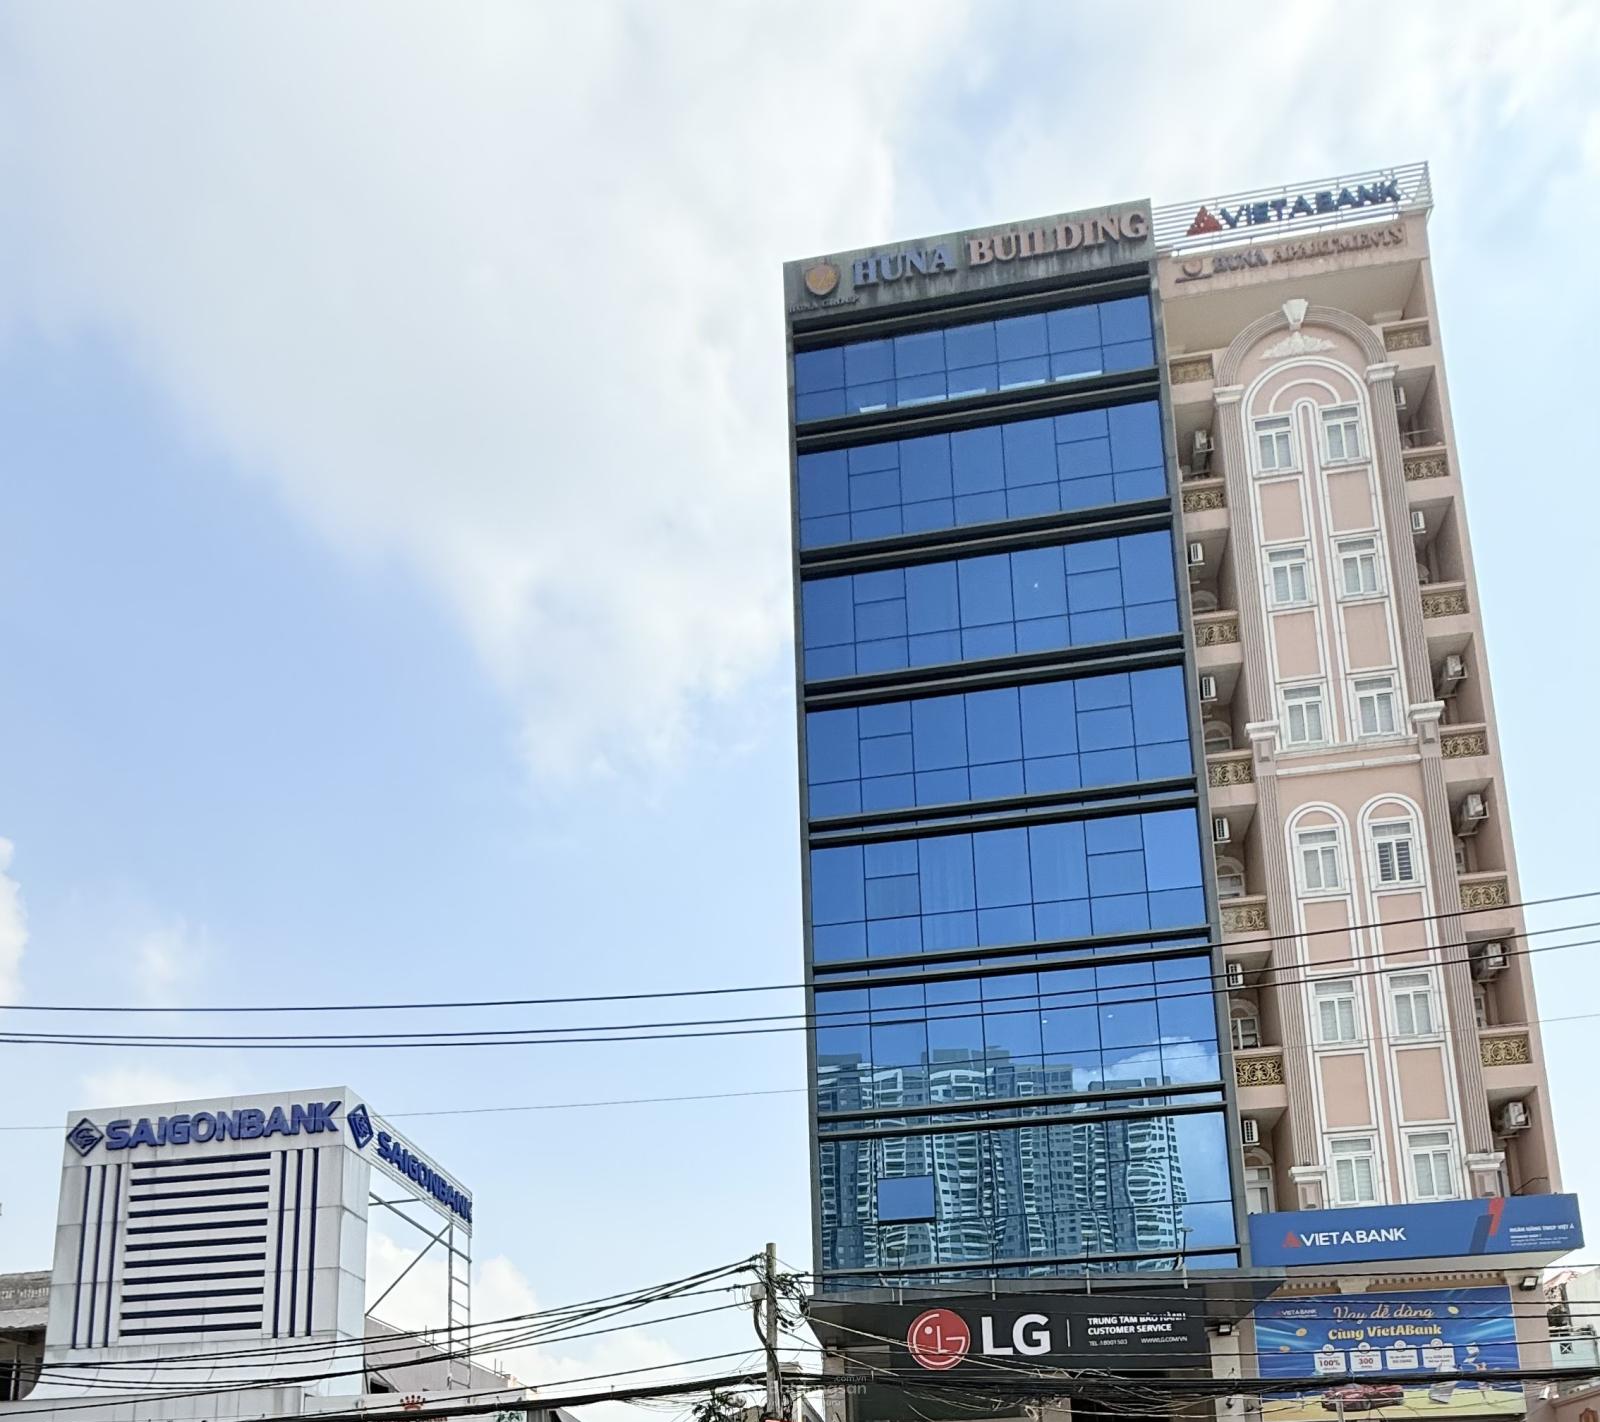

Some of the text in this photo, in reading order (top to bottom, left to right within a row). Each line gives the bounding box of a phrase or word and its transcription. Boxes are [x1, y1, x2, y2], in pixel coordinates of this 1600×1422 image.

[853, 212, 1149, 287] HUNA BUILDING
[105, 1100, 342, 1151] SAIGONBANK
[377, 1131, 473, 1224] SAIGONBANK
[1300, 1227, 1407, 1247] VIETABANK
[1087, 1316, 1118, 1326] TRUNG
[1333, 1303, 1435, 1325] Vay dễ dàng
[981, 1313, 1051, 1356] LG
[1087, 1323, 1173, 1336] CUSTOMER SERVICE
[1328, 1323, 1443, 1341] Cùng VietABank
[1318, 1358, 1342, 1368] 100%
[1357, 1356, 1375, 1366] 300
